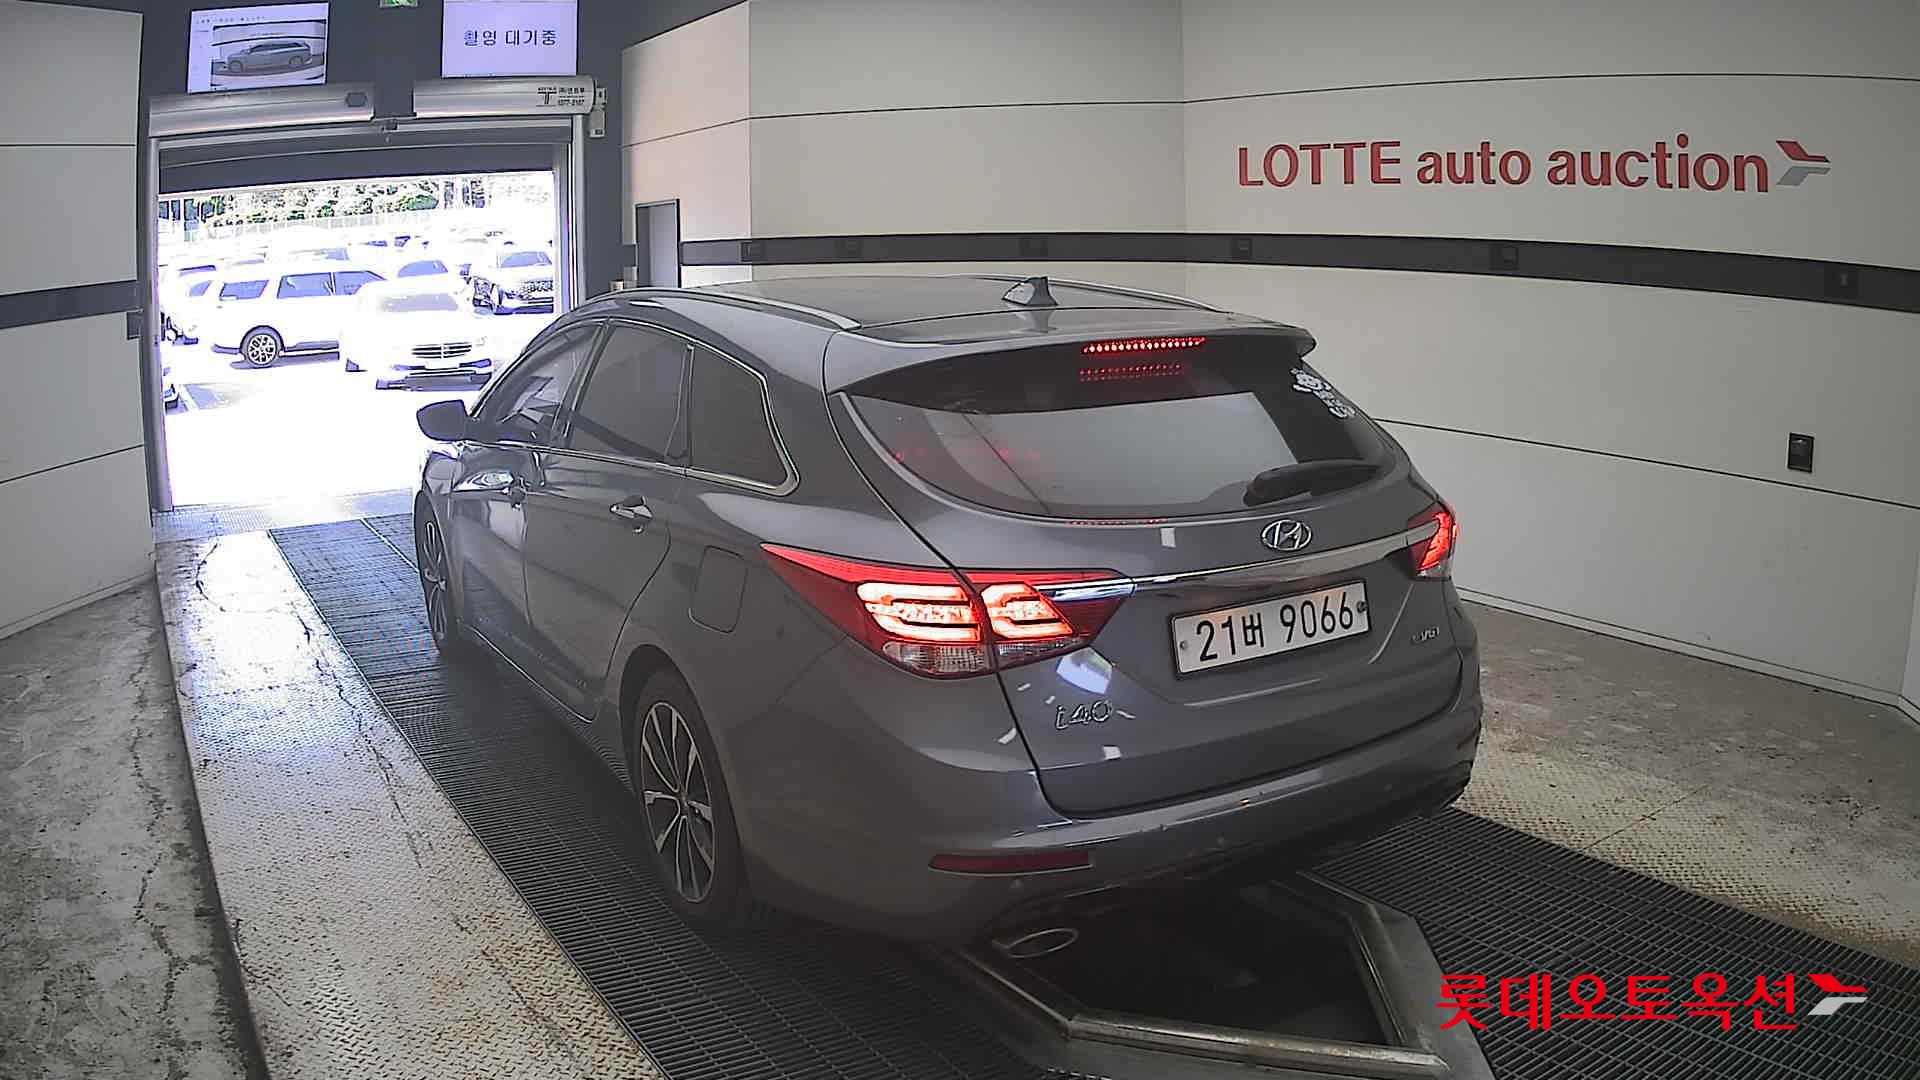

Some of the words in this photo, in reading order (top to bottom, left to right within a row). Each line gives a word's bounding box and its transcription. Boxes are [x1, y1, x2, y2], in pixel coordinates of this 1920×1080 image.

[505, 29, 557, 46] 대기중
[1238, 141, 1400, 186] LOTTE
[1417, 140, 1531, 185] auto
[1547, 133, 1769, 193] auction
[1195, 613, 1264, 662] 21버
[1279, 591, 1354, 643] 9066
